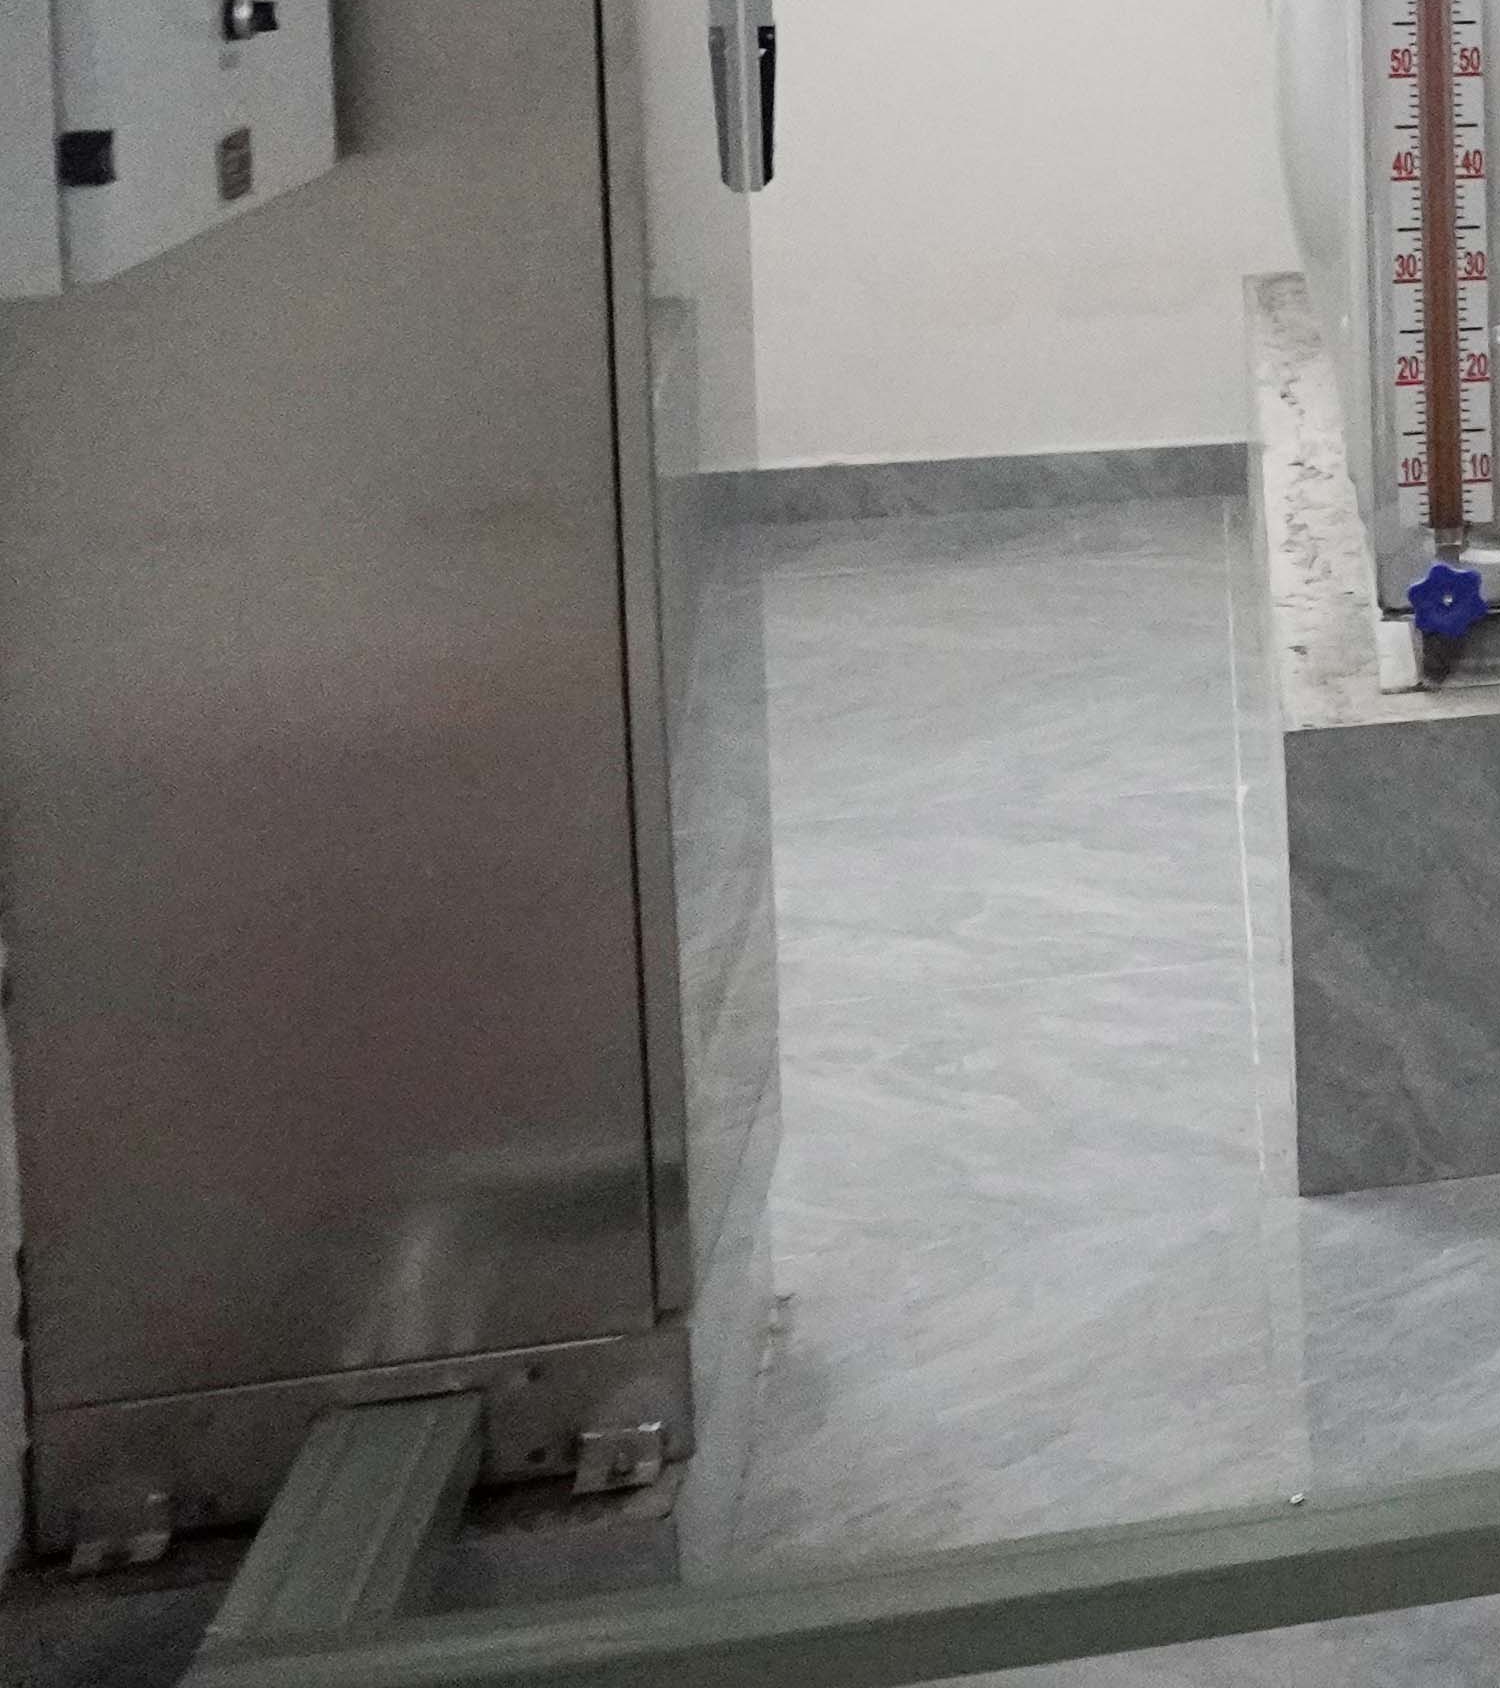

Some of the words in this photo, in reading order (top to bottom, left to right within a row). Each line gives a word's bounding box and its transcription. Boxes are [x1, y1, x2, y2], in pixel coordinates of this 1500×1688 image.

[1390, 49, 1413, 73] 50
[1458, 47, 1480, 71] 50
[1392, 151, 1414, 176] 40
[1461, 149, 1484, 174] 40
[1395, 254, 1417, 278] 30
[1463, 251, 1485, 275] 30
[1397, 356, 1420, 381] 20
[1466, 354, 1488, 377] 20
[1401, 457, 1423, 482] 10
[1470, 453, 1490, 478] 10
